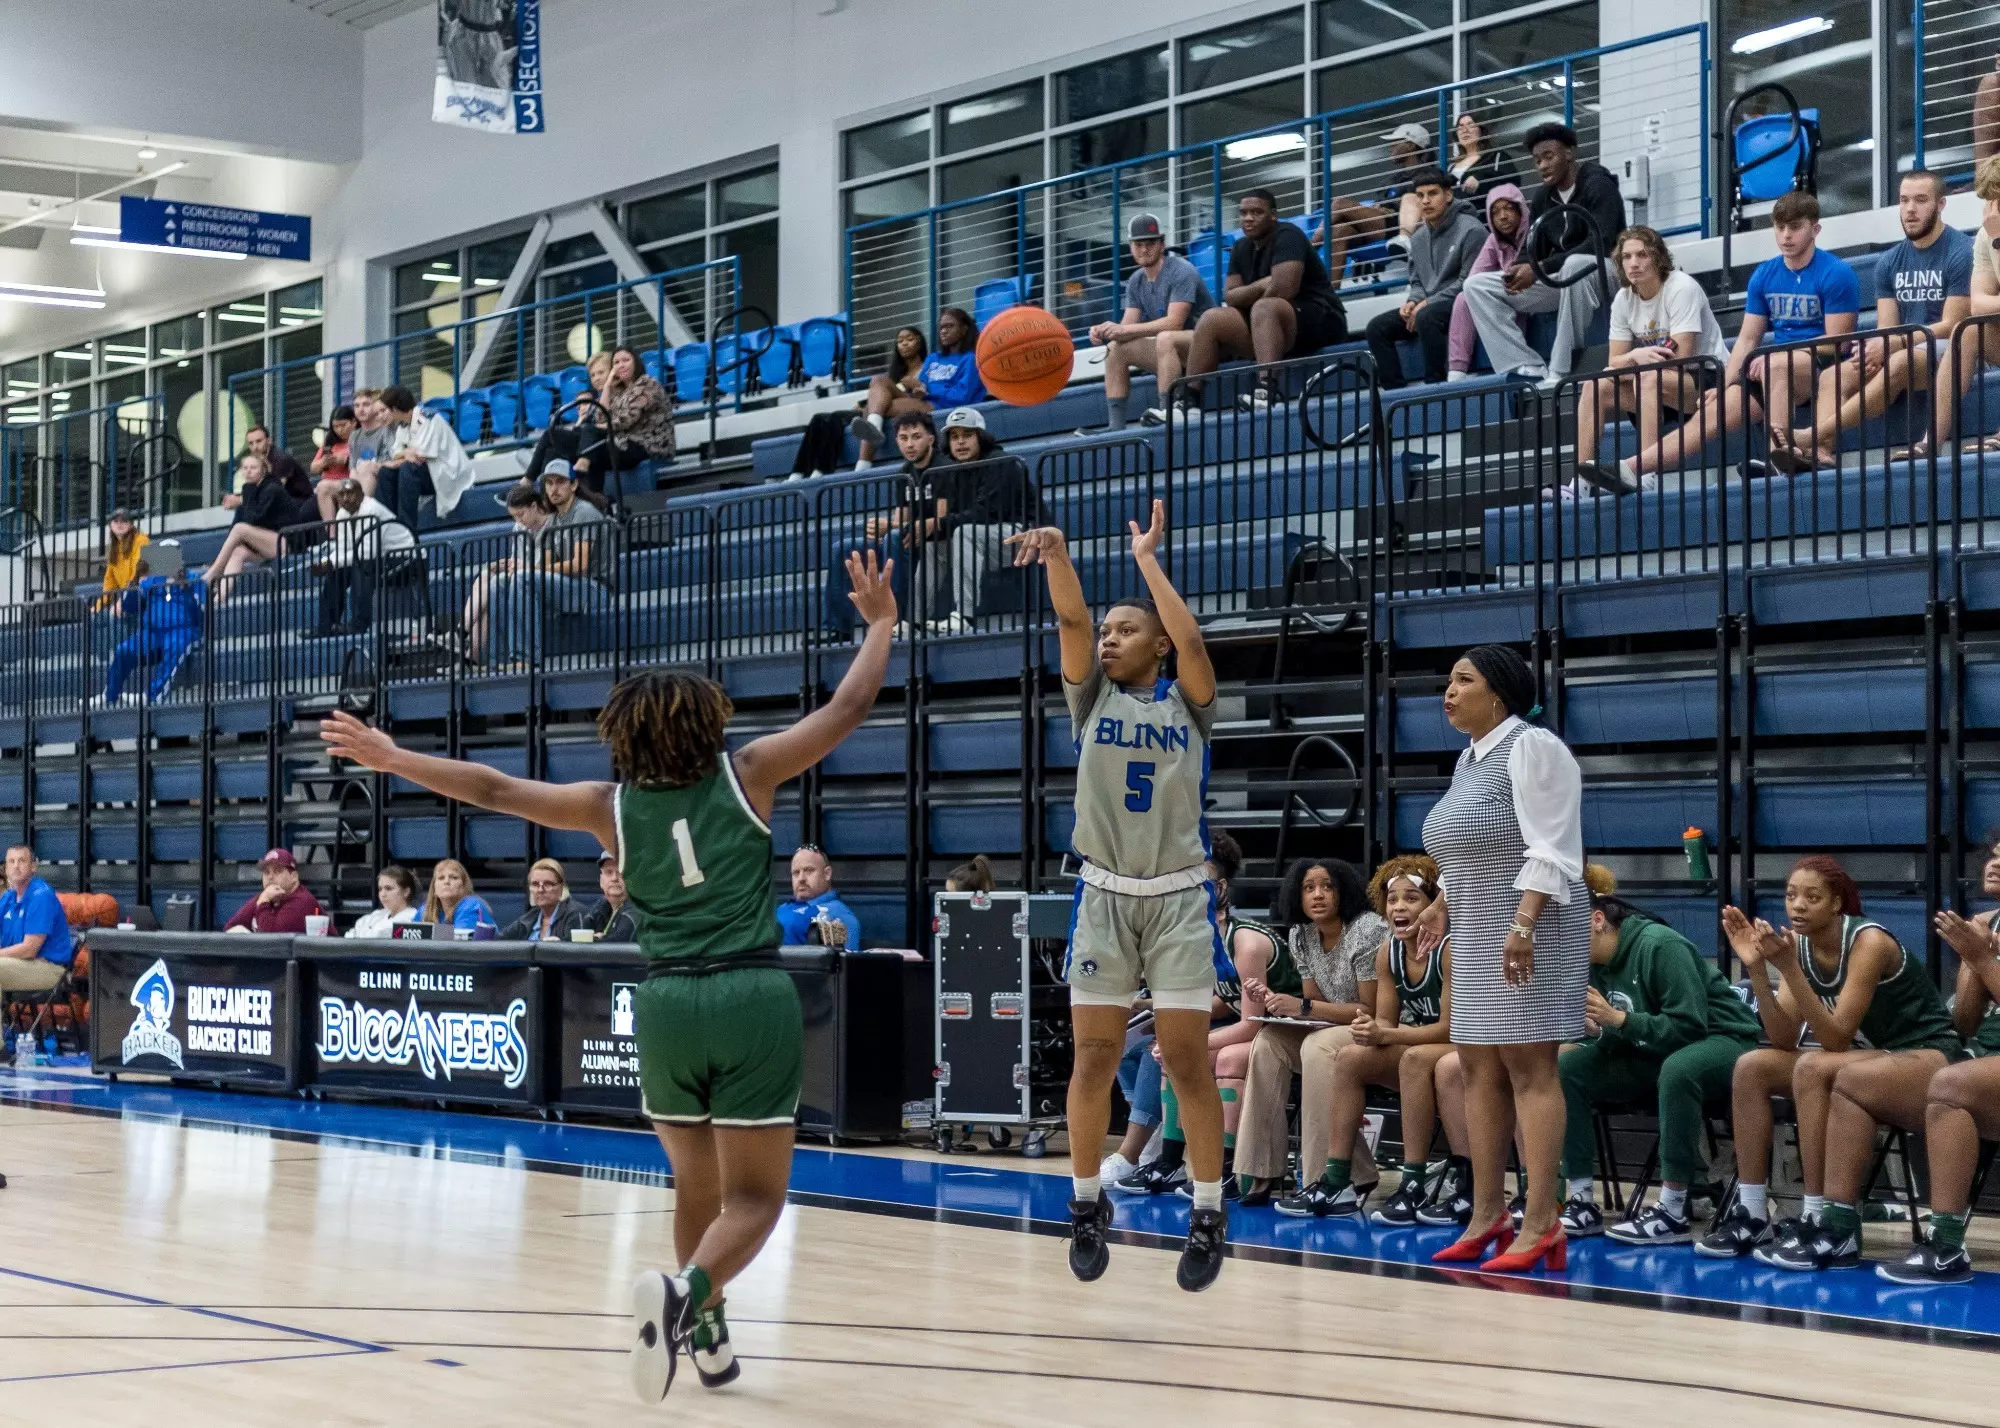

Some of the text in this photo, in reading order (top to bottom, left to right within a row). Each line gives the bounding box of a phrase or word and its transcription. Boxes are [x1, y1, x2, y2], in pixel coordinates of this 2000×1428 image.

[519, 98, 539, 130] 3
[182, 205, 260, 224] CONCESSIONS
[182, 219, 249, 237] RESTROOMS
[256, 229, 298, 242] WOMEN
[182, 234, 249, 252] RESTROOMS
[256, 243, 281, 256] MEN
[1895, 269, 1943, 289] BLINN
[1895, 288, 1946, 302] COLLEGE
[1094, 717, 1189, 753] BLINN
[1124, 761, 1156, 812] 5
[672, 818, 705, 887] 1
[359, 971, 474, 992] BLINN COLLEGE
[187, 985, 272, 1026] BUCCANEER
[124, 1031, 181, 1059] BACKER
[187, 1026, 272, 1056] BACKER CLUB
[316, 994, 528, 1089] BUCCANEERS
[583, 1039, 614, 1052] BLINN
[581, 1054, 620, 1071] ALUMNI
[583, 1073, 641, 1087] ASSOCIAT
